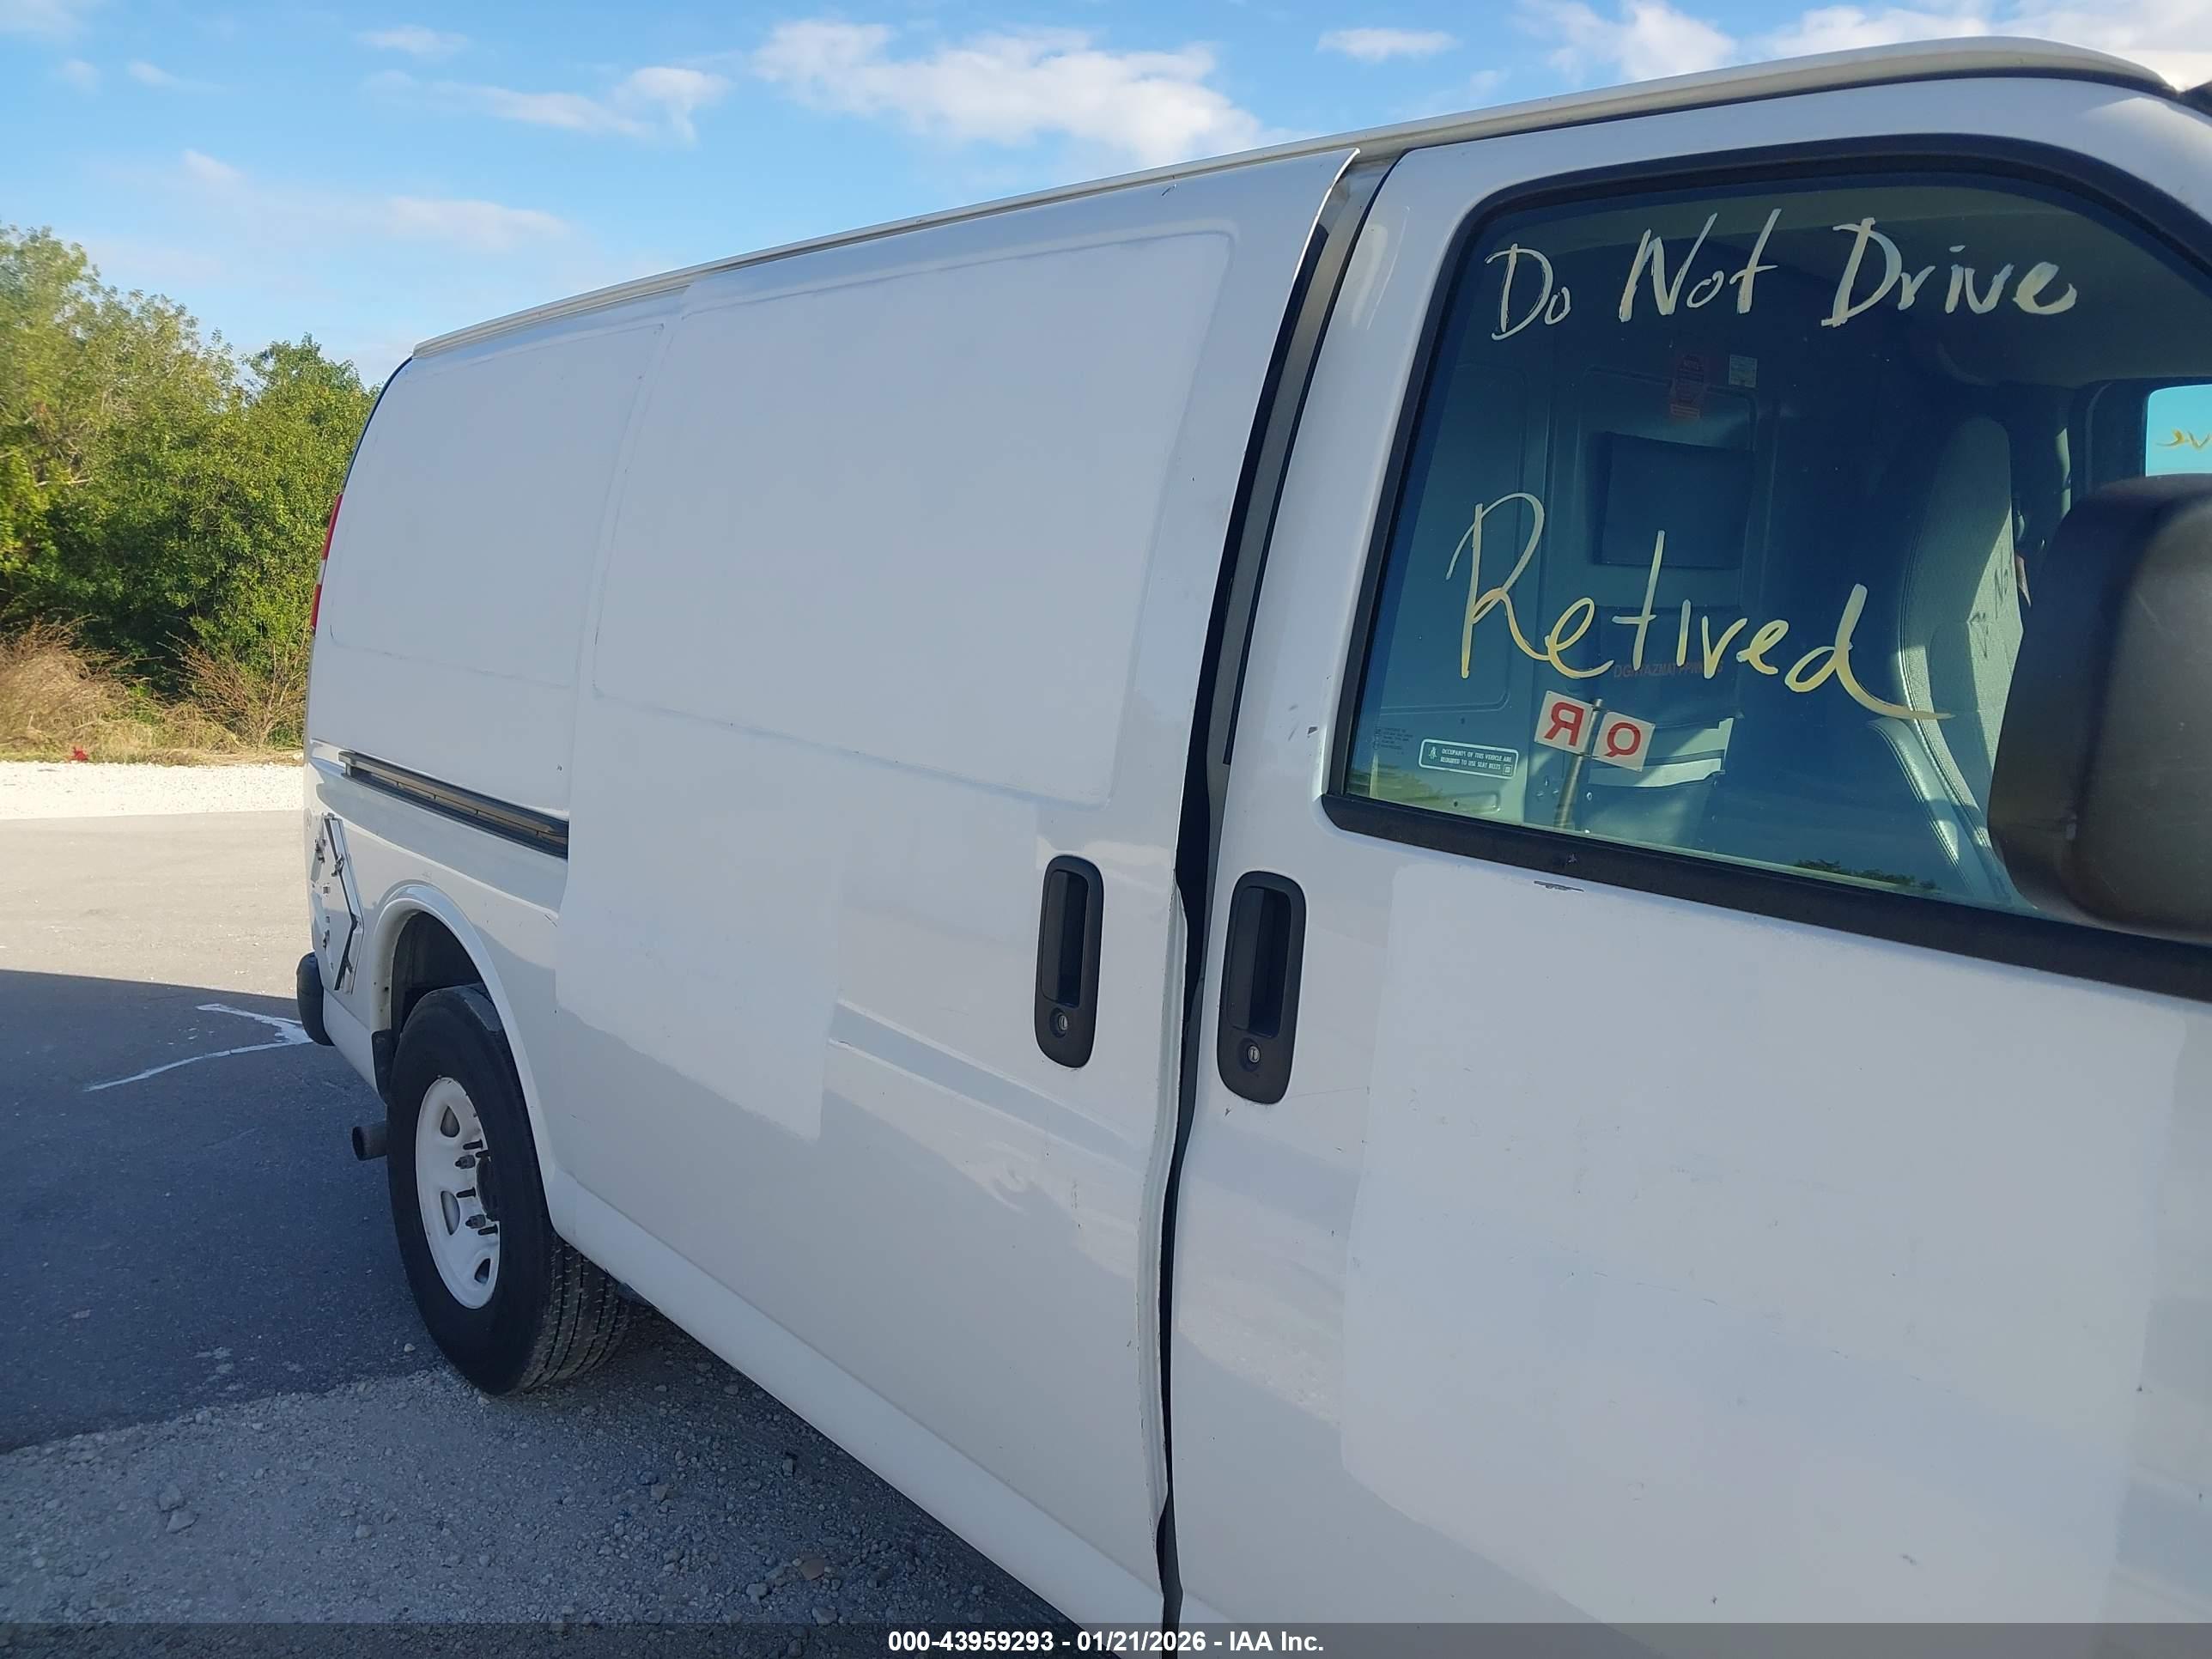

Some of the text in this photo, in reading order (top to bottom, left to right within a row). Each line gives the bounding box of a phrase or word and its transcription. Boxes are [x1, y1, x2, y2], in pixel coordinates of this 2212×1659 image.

[1485, 208, 2077, 341] Do Not Drive
[1446, 492, 1956, 720] Retired
[1440, 757, 1460, 765] REQUIRED
[1488, 762, 1501, 770] BELTS
[1442, 748, 1512, 763] OCCUPANTS OF THIS VEHICLE ARE
